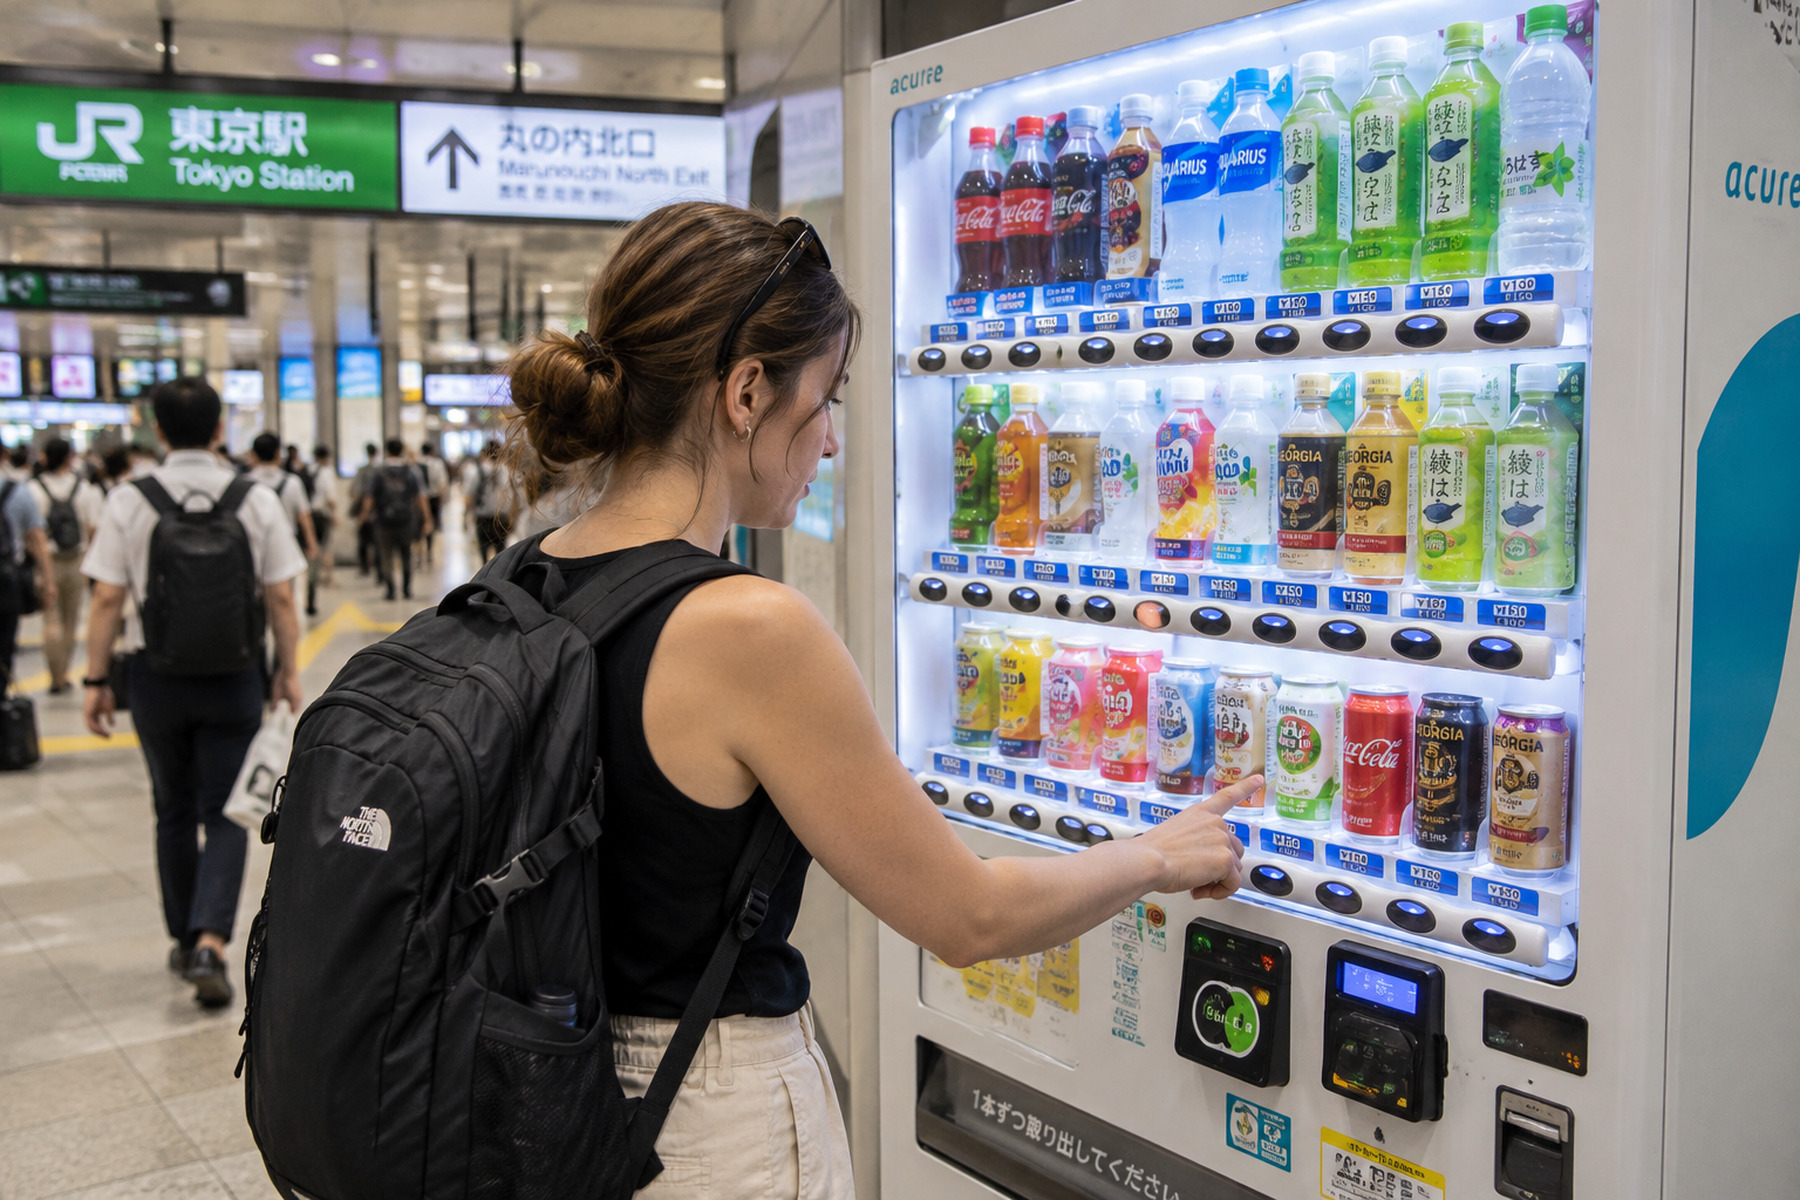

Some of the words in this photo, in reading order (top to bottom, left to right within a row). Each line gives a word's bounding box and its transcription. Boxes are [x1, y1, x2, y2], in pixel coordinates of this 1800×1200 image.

[37, 101, 144, 164] JR
[168, 105, 309, 157] 東京駅
[499, 123, 654, 158] 丸の内北口
[169, 156, 254, 192] Tokyo
[259, 160, 355, 193] Station
